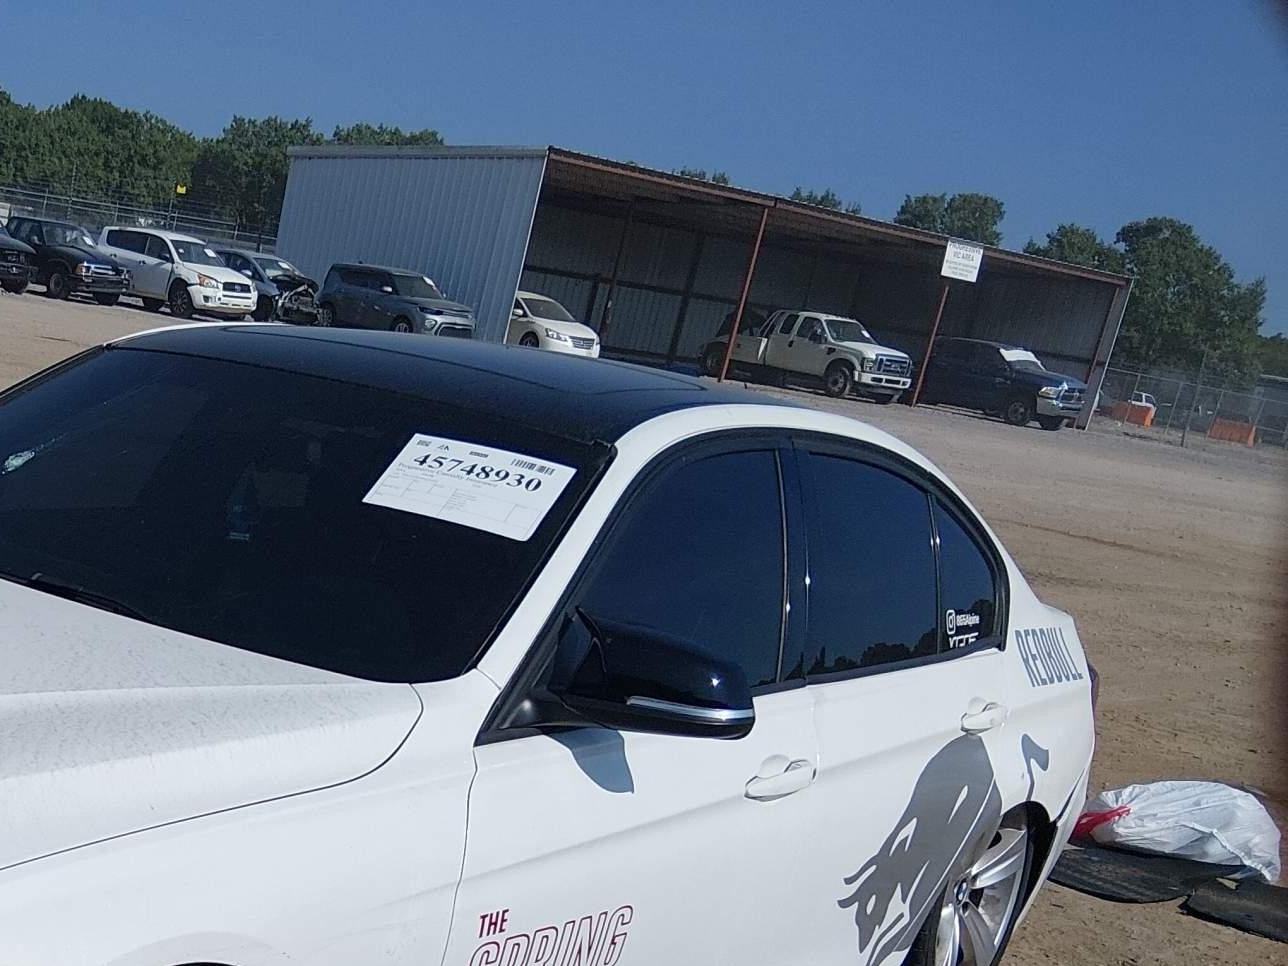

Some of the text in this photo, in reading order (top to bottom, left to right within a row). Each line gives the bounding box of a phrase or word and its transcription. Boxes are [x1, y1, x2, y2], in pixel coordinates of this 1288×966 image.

[413, 453, 543, 492] 45748930
[1014, 627, 1085, 688] REDBULL
[478, 908, 510, 938] THE
